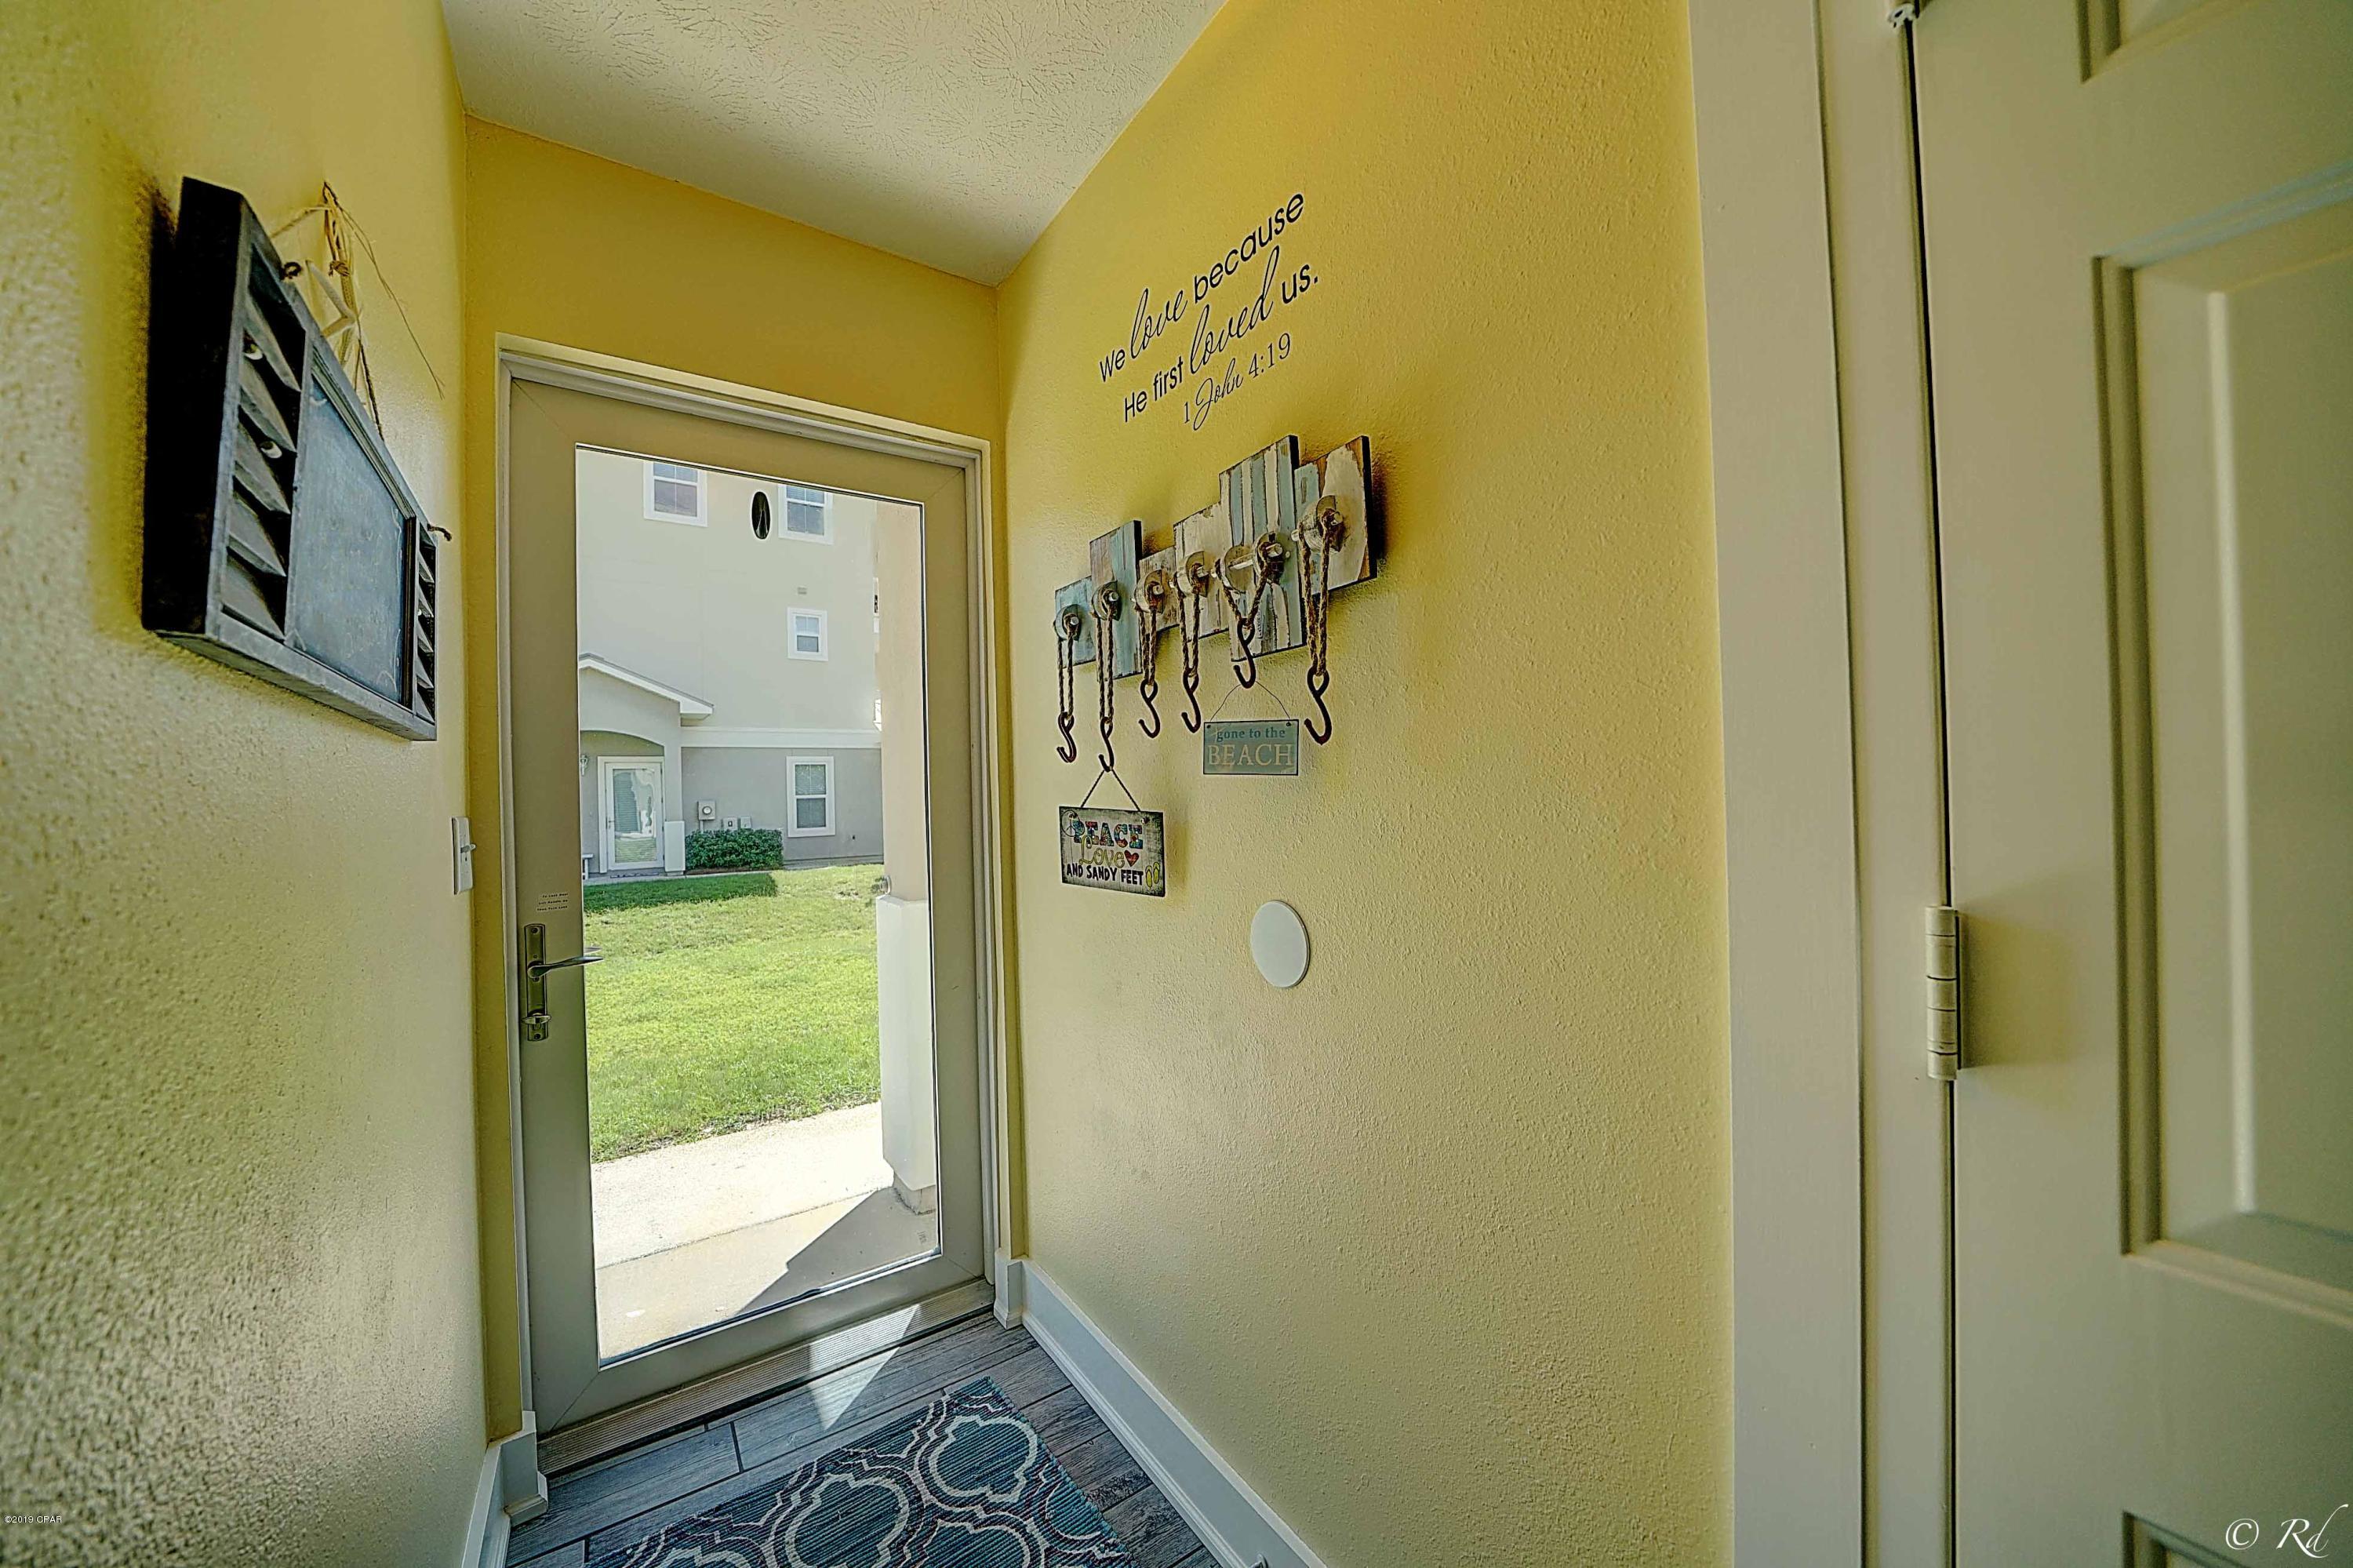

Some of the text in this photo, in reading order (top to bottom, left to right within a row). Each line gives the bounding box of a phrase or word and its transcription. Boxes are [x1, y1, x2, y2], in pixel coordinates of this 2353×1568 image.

[1100, 193, 1304, 383] We love because
[1124, 245, 1318, 423] He first loved us.
[1184, 333, 1291, 431] 1 John 4:19
[1217, 727, 1286, 742] gone to the
[1208, 744, 1294, 766] BEACH
[1071, 818, 1144, 849] PEACE
[1078, 835, 1125, 868] Love
[1067, 863, 1144, 886] AND SANDY FEET
